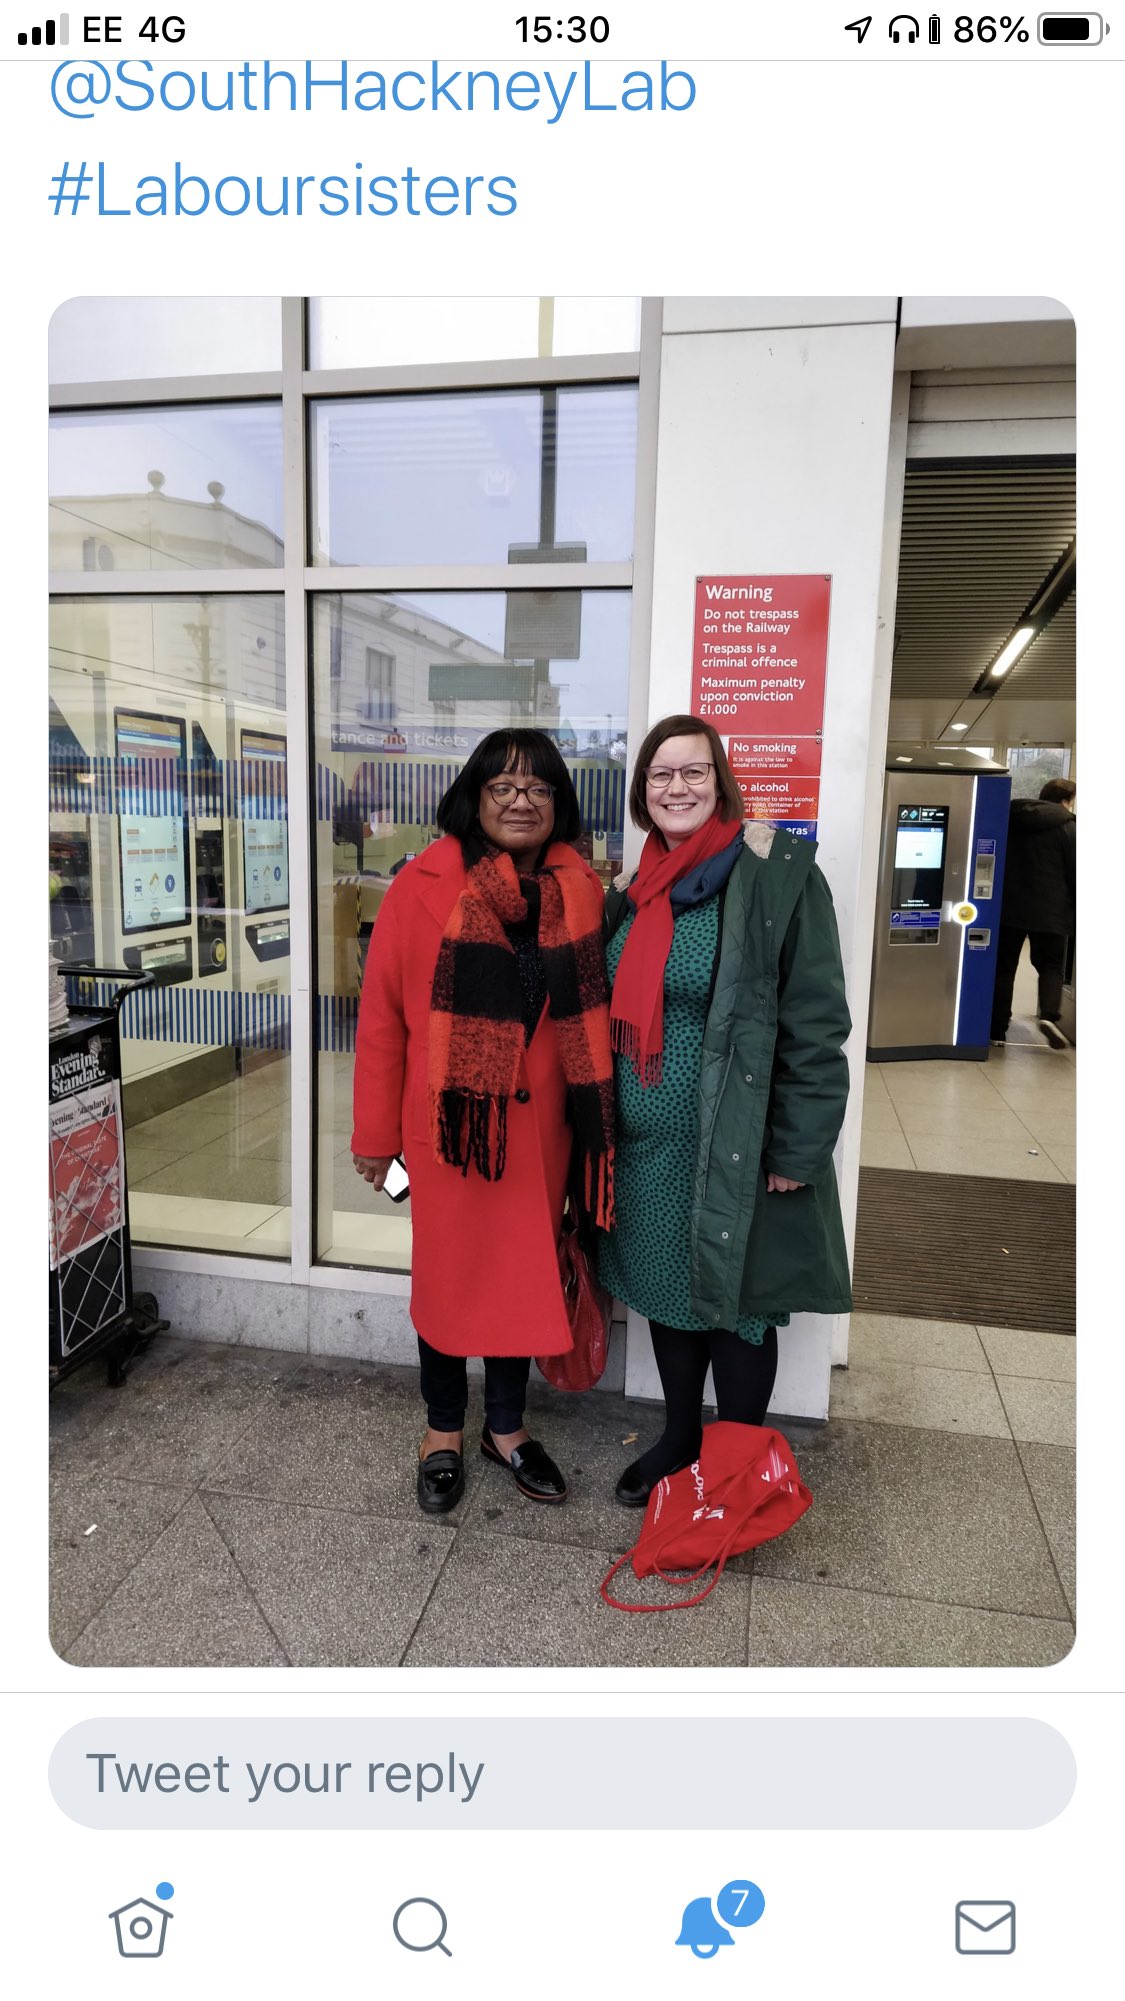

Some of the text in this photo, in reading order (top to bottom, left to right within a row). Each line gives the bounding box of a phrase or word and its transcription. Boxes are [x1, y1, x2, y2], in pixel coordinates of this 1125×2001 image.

[705, 584, 774, 602] Warning
[704, 608, 799, 621] Do not trespass
[703, 622, 791, 635] on the Railway
[702, 643, 777, 655] Trespass is a
[701, 656, 798, 667] criminal offence
[701, 677, 805, 690] Maximum penalty
[700, 691, 794, 703] upon conviction
[331, 730, 469, 747] tance and tickets
[733, 742, 797, 755] No smoking
[738, 782, 789, 792] o alcohol
[786, 827, 808, 835] eras
[58, 1052, 80, 1065] London
[51, 1053, 99, 1080] Evening
[51, 1112, 74, 1126] vening
